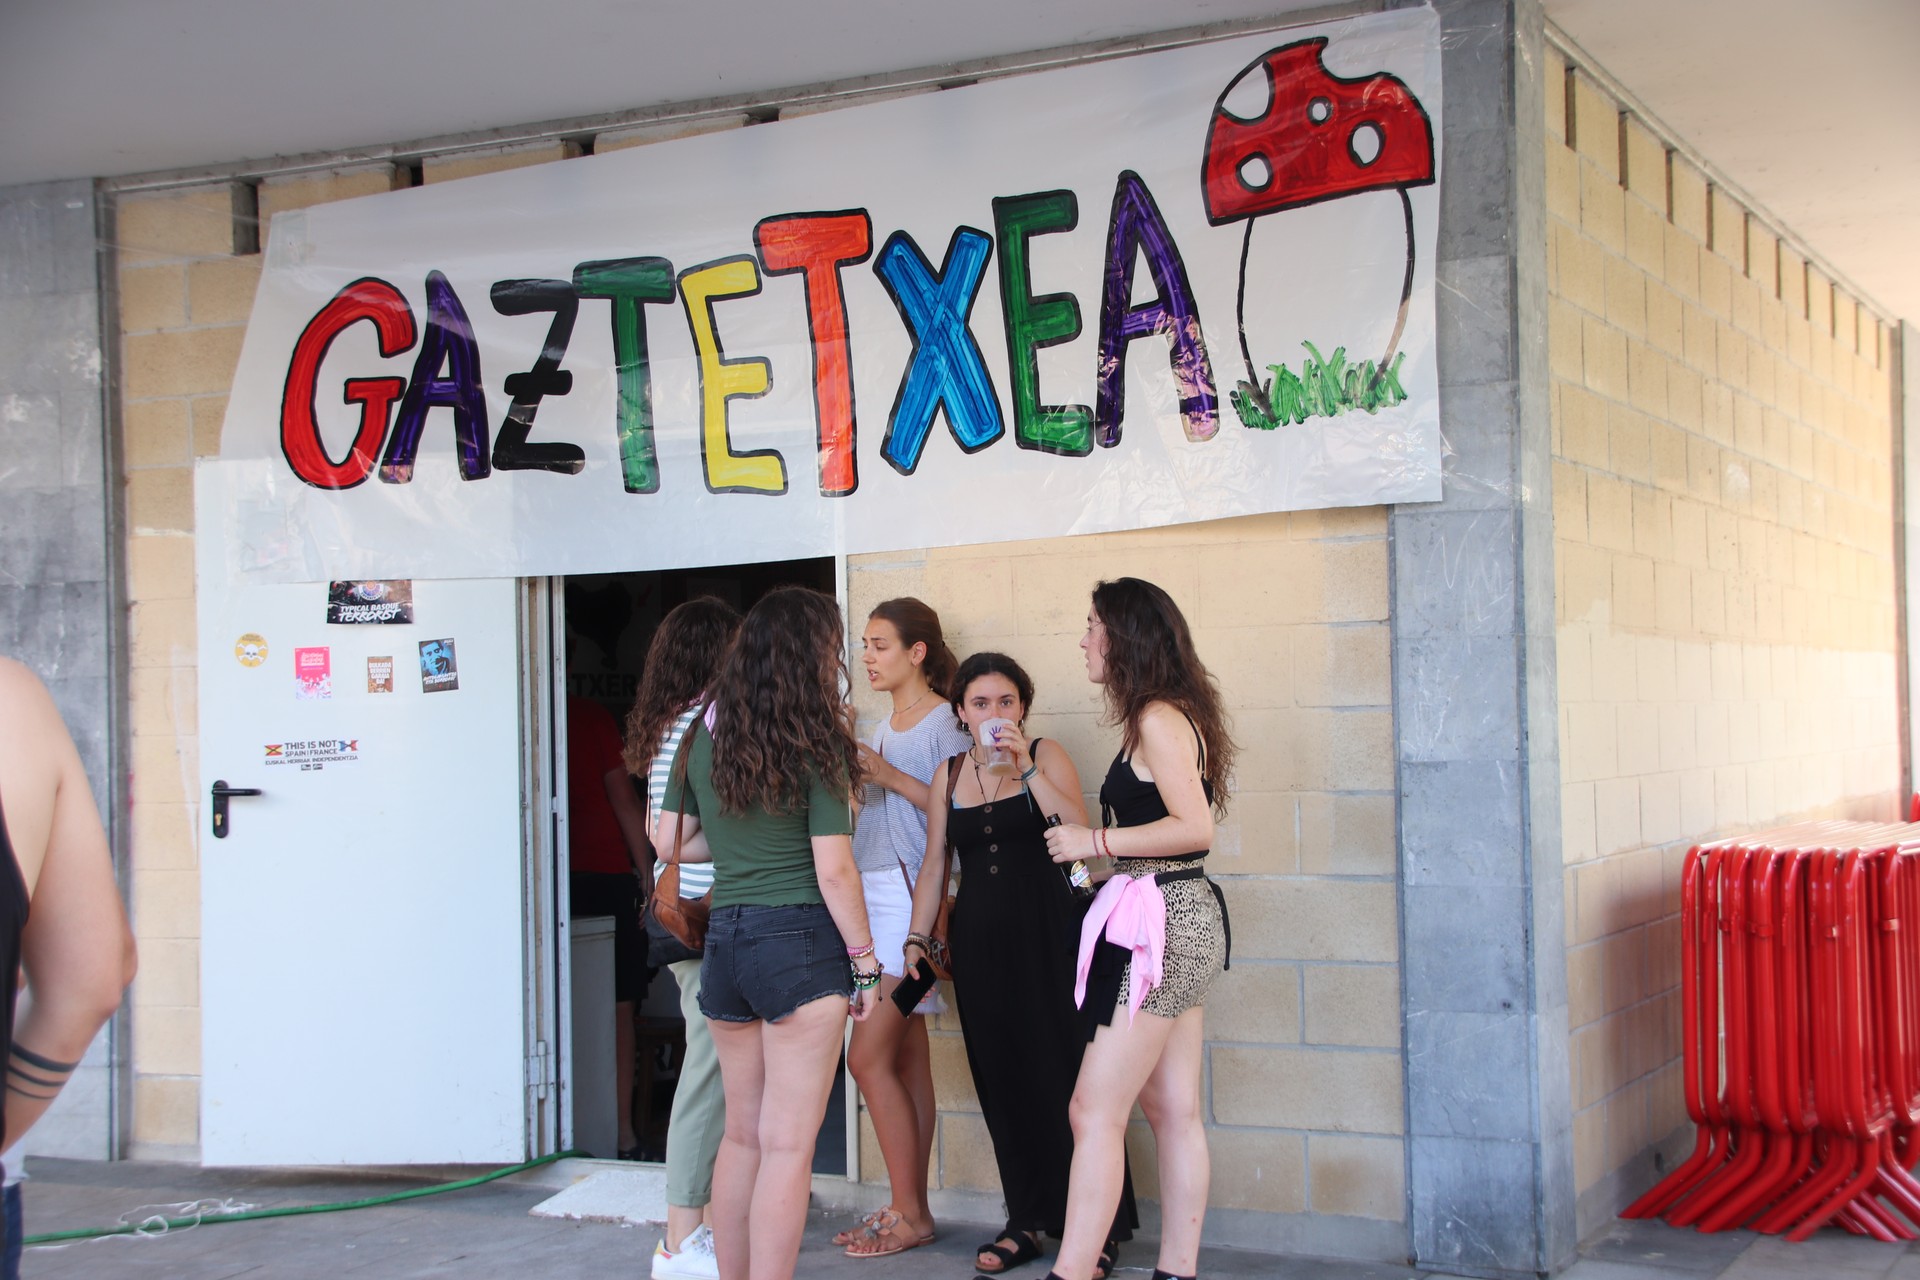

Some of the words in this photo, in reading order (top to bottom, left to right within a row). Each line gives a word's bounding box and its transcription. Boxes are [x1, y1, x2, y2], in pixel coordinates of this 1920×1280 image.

[280, 169, 1219, 497] GAZTETXEA
[341, 605, 370, 613] TYPICAL
[371, 602, 399, 611] BASQUE
[338, 608, 401, 623] TERRORIST
[285, 742, 306, 750] THIS
[307, 741, 317, 749] IS
[318, 740, 338, 748] NOT
[312, 755, 358, 763] INDEPENDENTZIA
